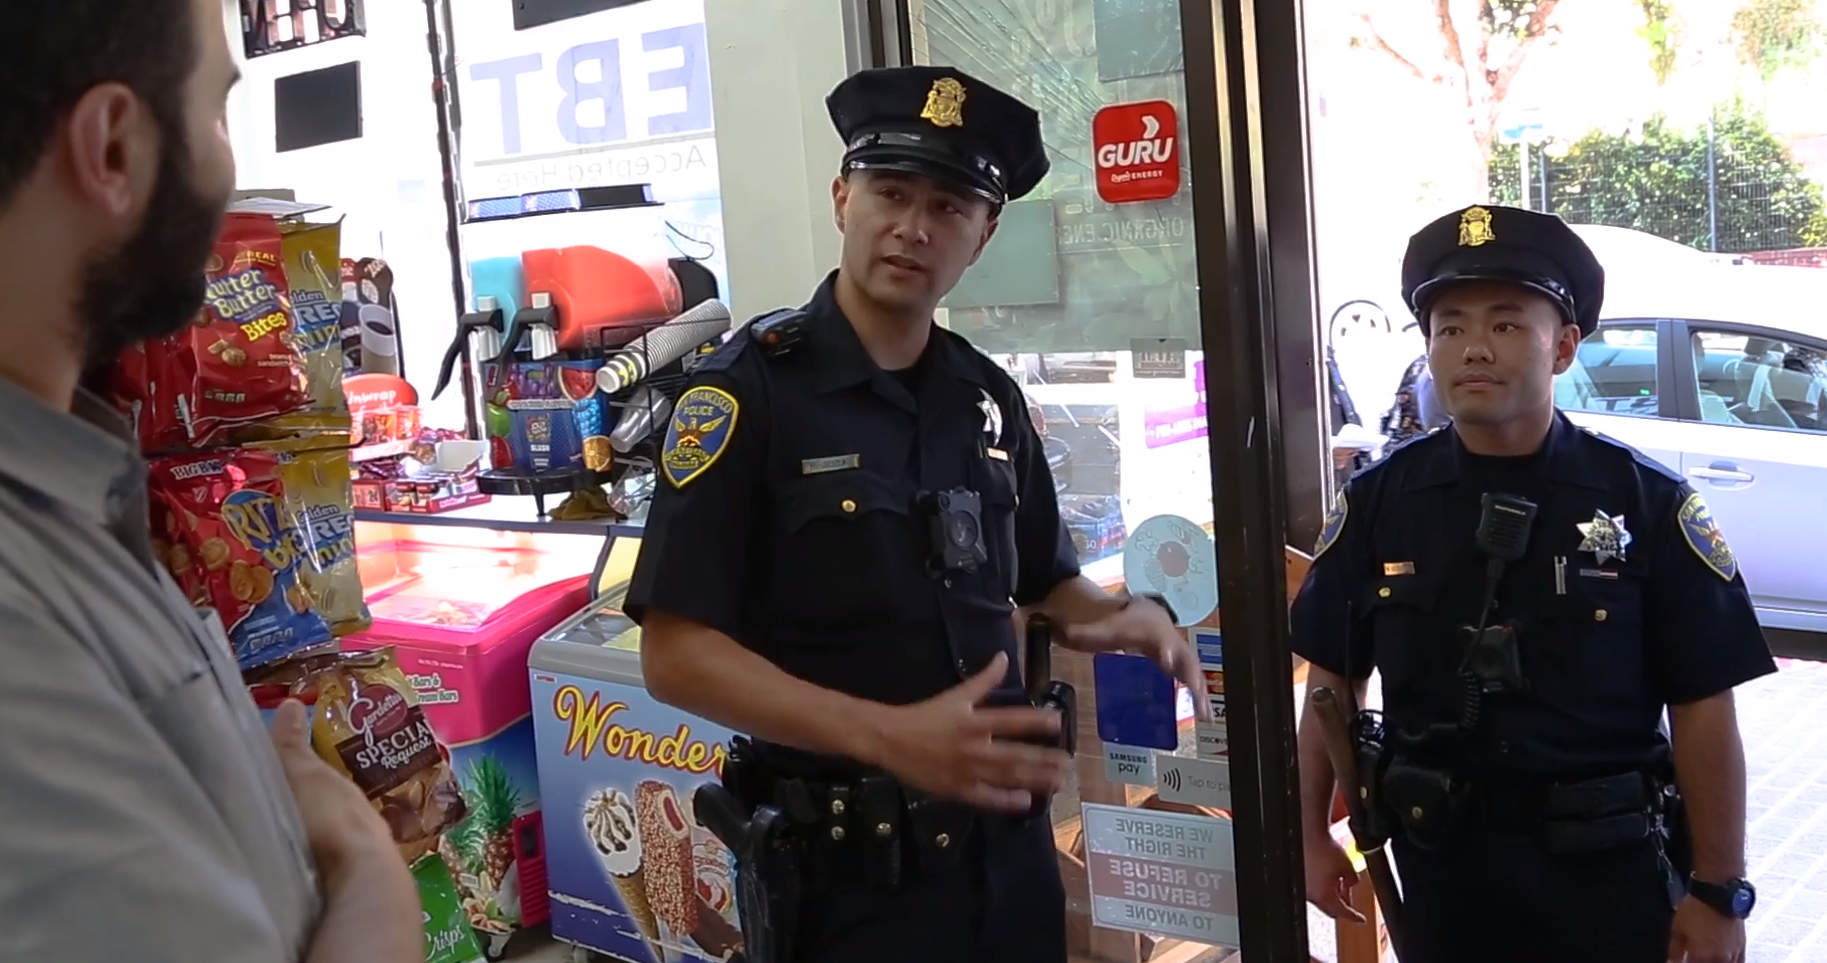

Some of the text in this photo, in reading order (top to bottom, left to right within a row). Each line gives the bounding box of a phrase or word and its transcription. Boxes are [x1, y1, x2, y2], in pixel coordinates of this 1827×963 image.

[1098, 137, 1174, 168] GURU
[1131, 170, 1164, 180] ENERGY
[246, 250, 276, 261] REAL
[213, 284, 276, 318] Butter
[240, 311, 287, 341] Bites
[684, 405, 715, 416] POLICE
[171, 462, 198, 481] BIG
[412, 673, 432, 688] Bars
[416, 688, 459, 704] ream Bars
[356, 720, 431, 769] SPECIA
[380, 735, 432, 769] Request
[1109, 752, 1148, 764] SAMSUNG
[1118, 762, 1140, 775] pay
[1186, 775, 1204, 788] Tap
[1206, 778, 1216, 789] to
